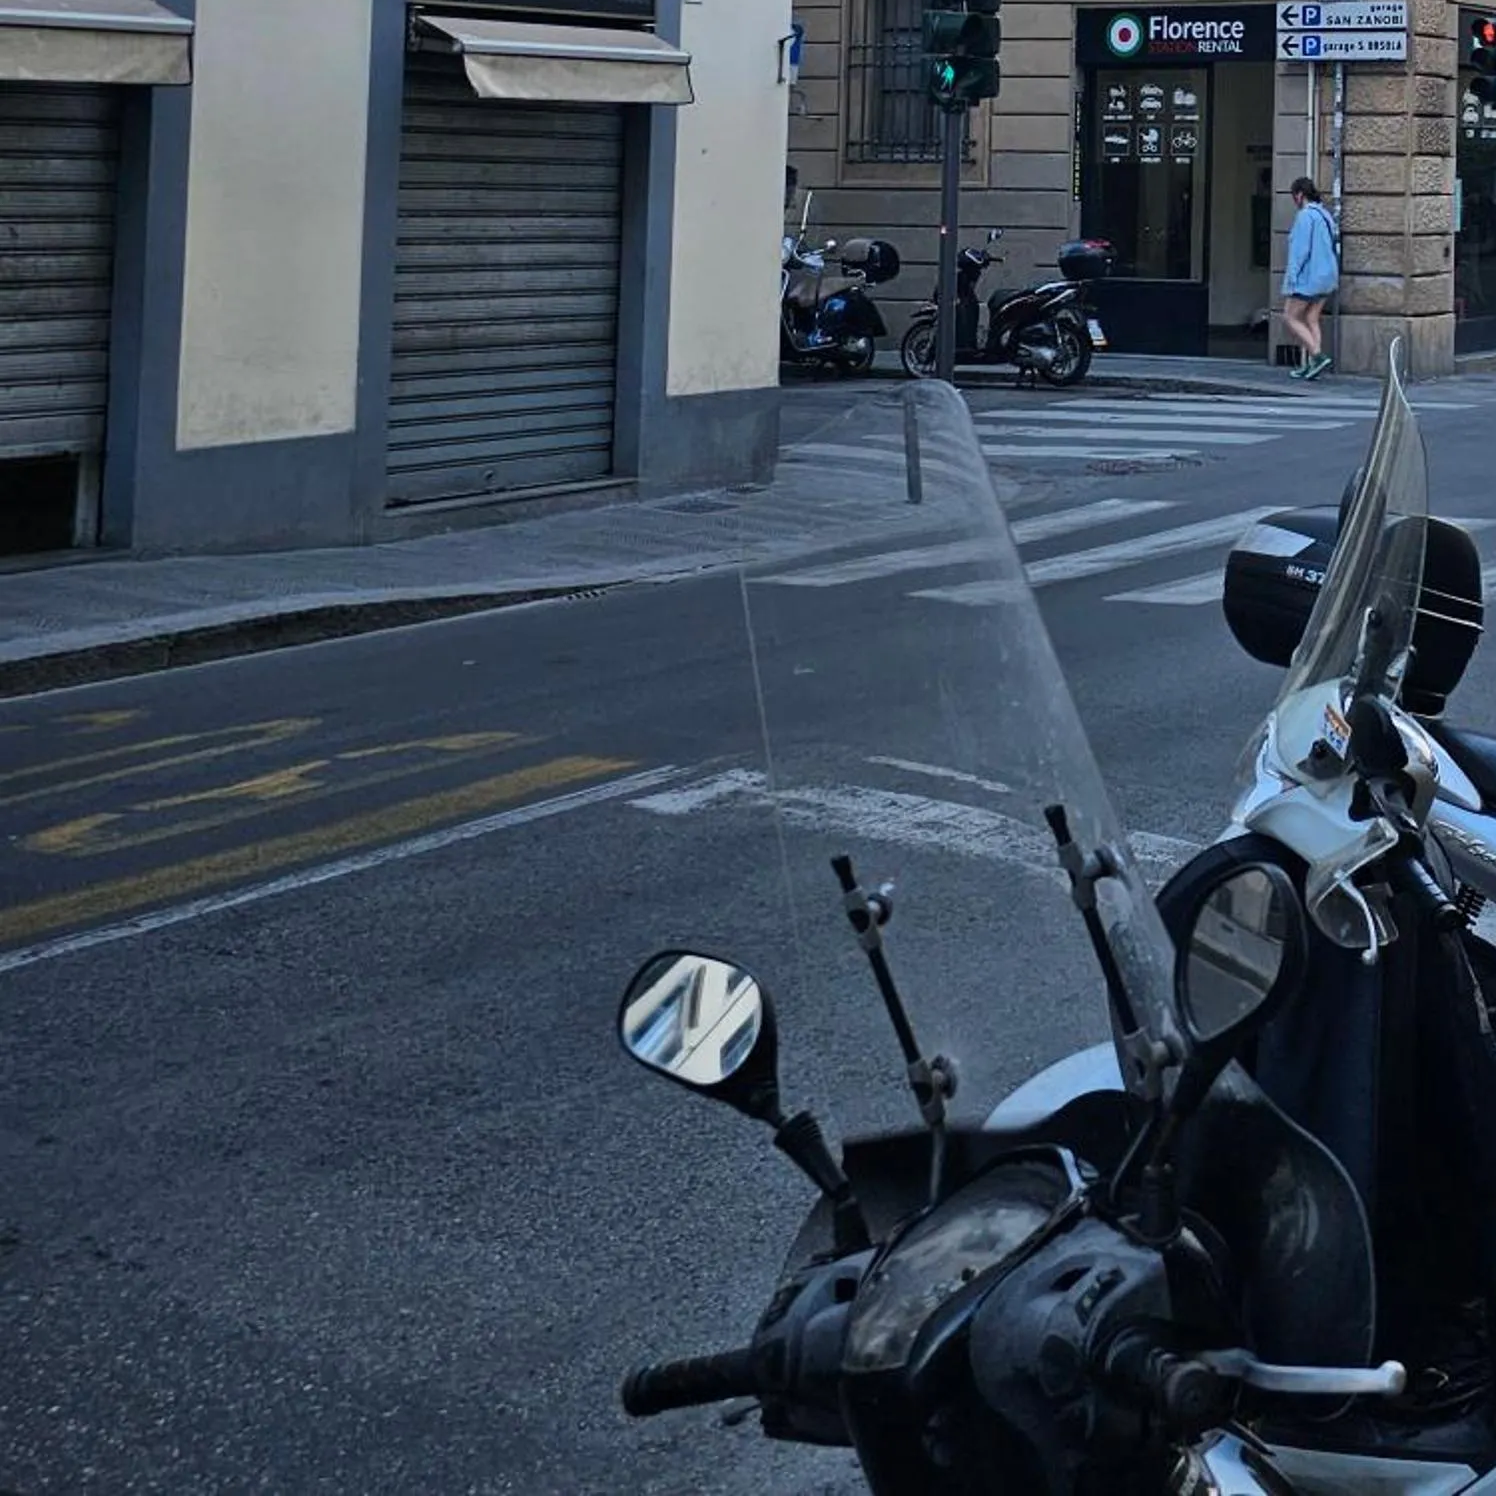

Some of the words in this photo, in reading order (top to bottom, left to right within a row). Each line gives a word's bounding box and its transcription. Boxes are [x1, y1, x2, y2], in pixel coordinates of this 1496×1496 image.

[1306, 7, 1317, 24] P
[1326, 15, 1351, 25] SAN
[1357, 15, 1403, 25] ZANOBI
[1149, 15, 1244, 39] Florence
[1198, 40, 1243, 53] RENTAL
[1305, 37, 1318, 54] P
